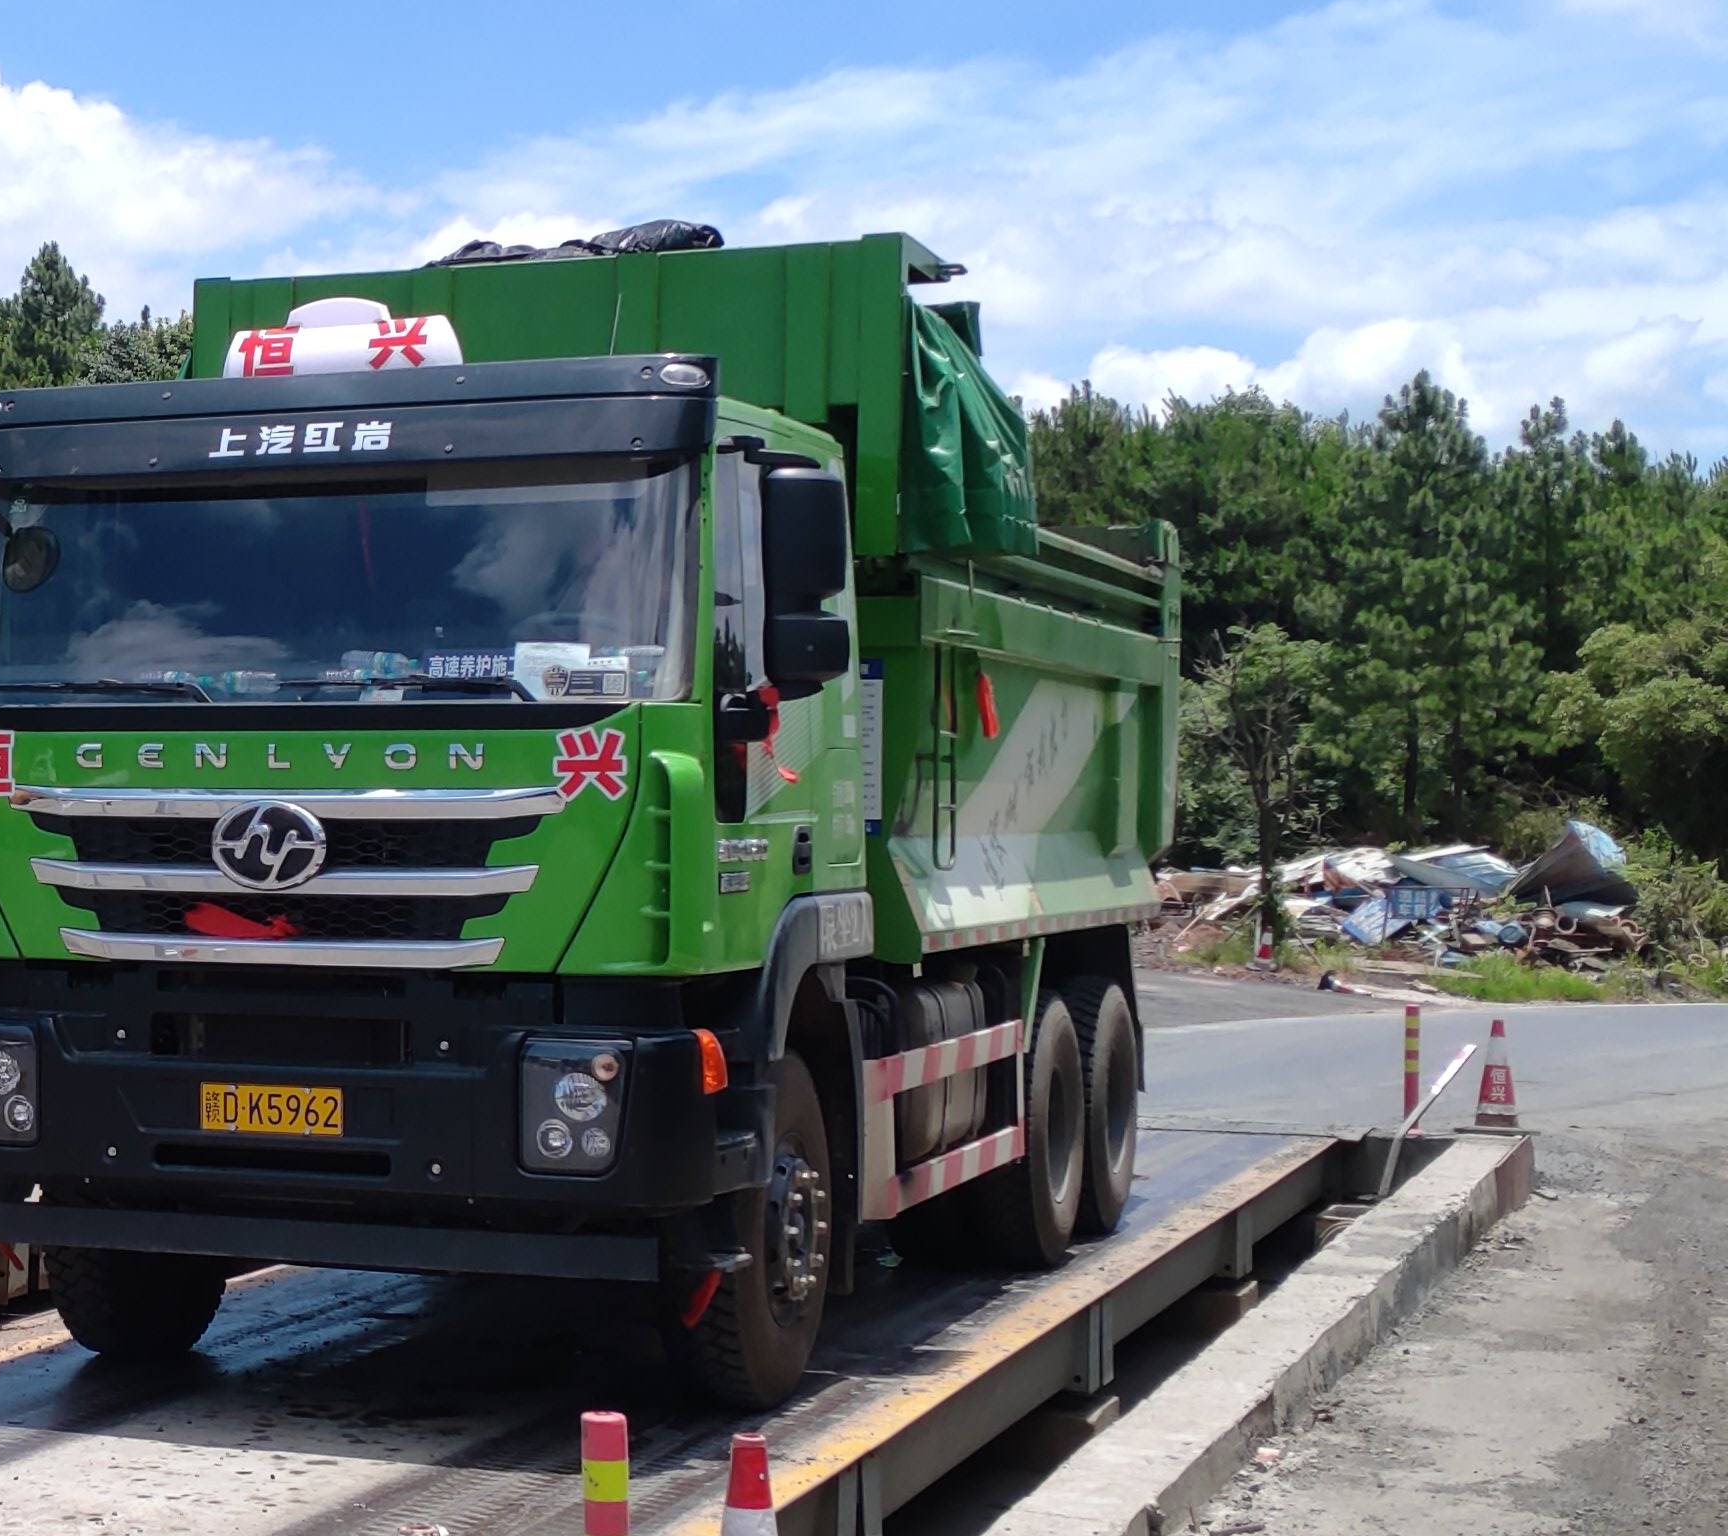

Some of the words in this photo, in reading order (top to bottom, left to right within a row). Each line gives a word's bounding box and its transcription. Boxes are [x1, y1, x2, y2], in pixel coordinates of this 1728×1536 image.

[208, 421, 393, 458] 上汽红岩
[76, 742, 484, 770] GENLYON
[553, 727, 628, 801] 兴
